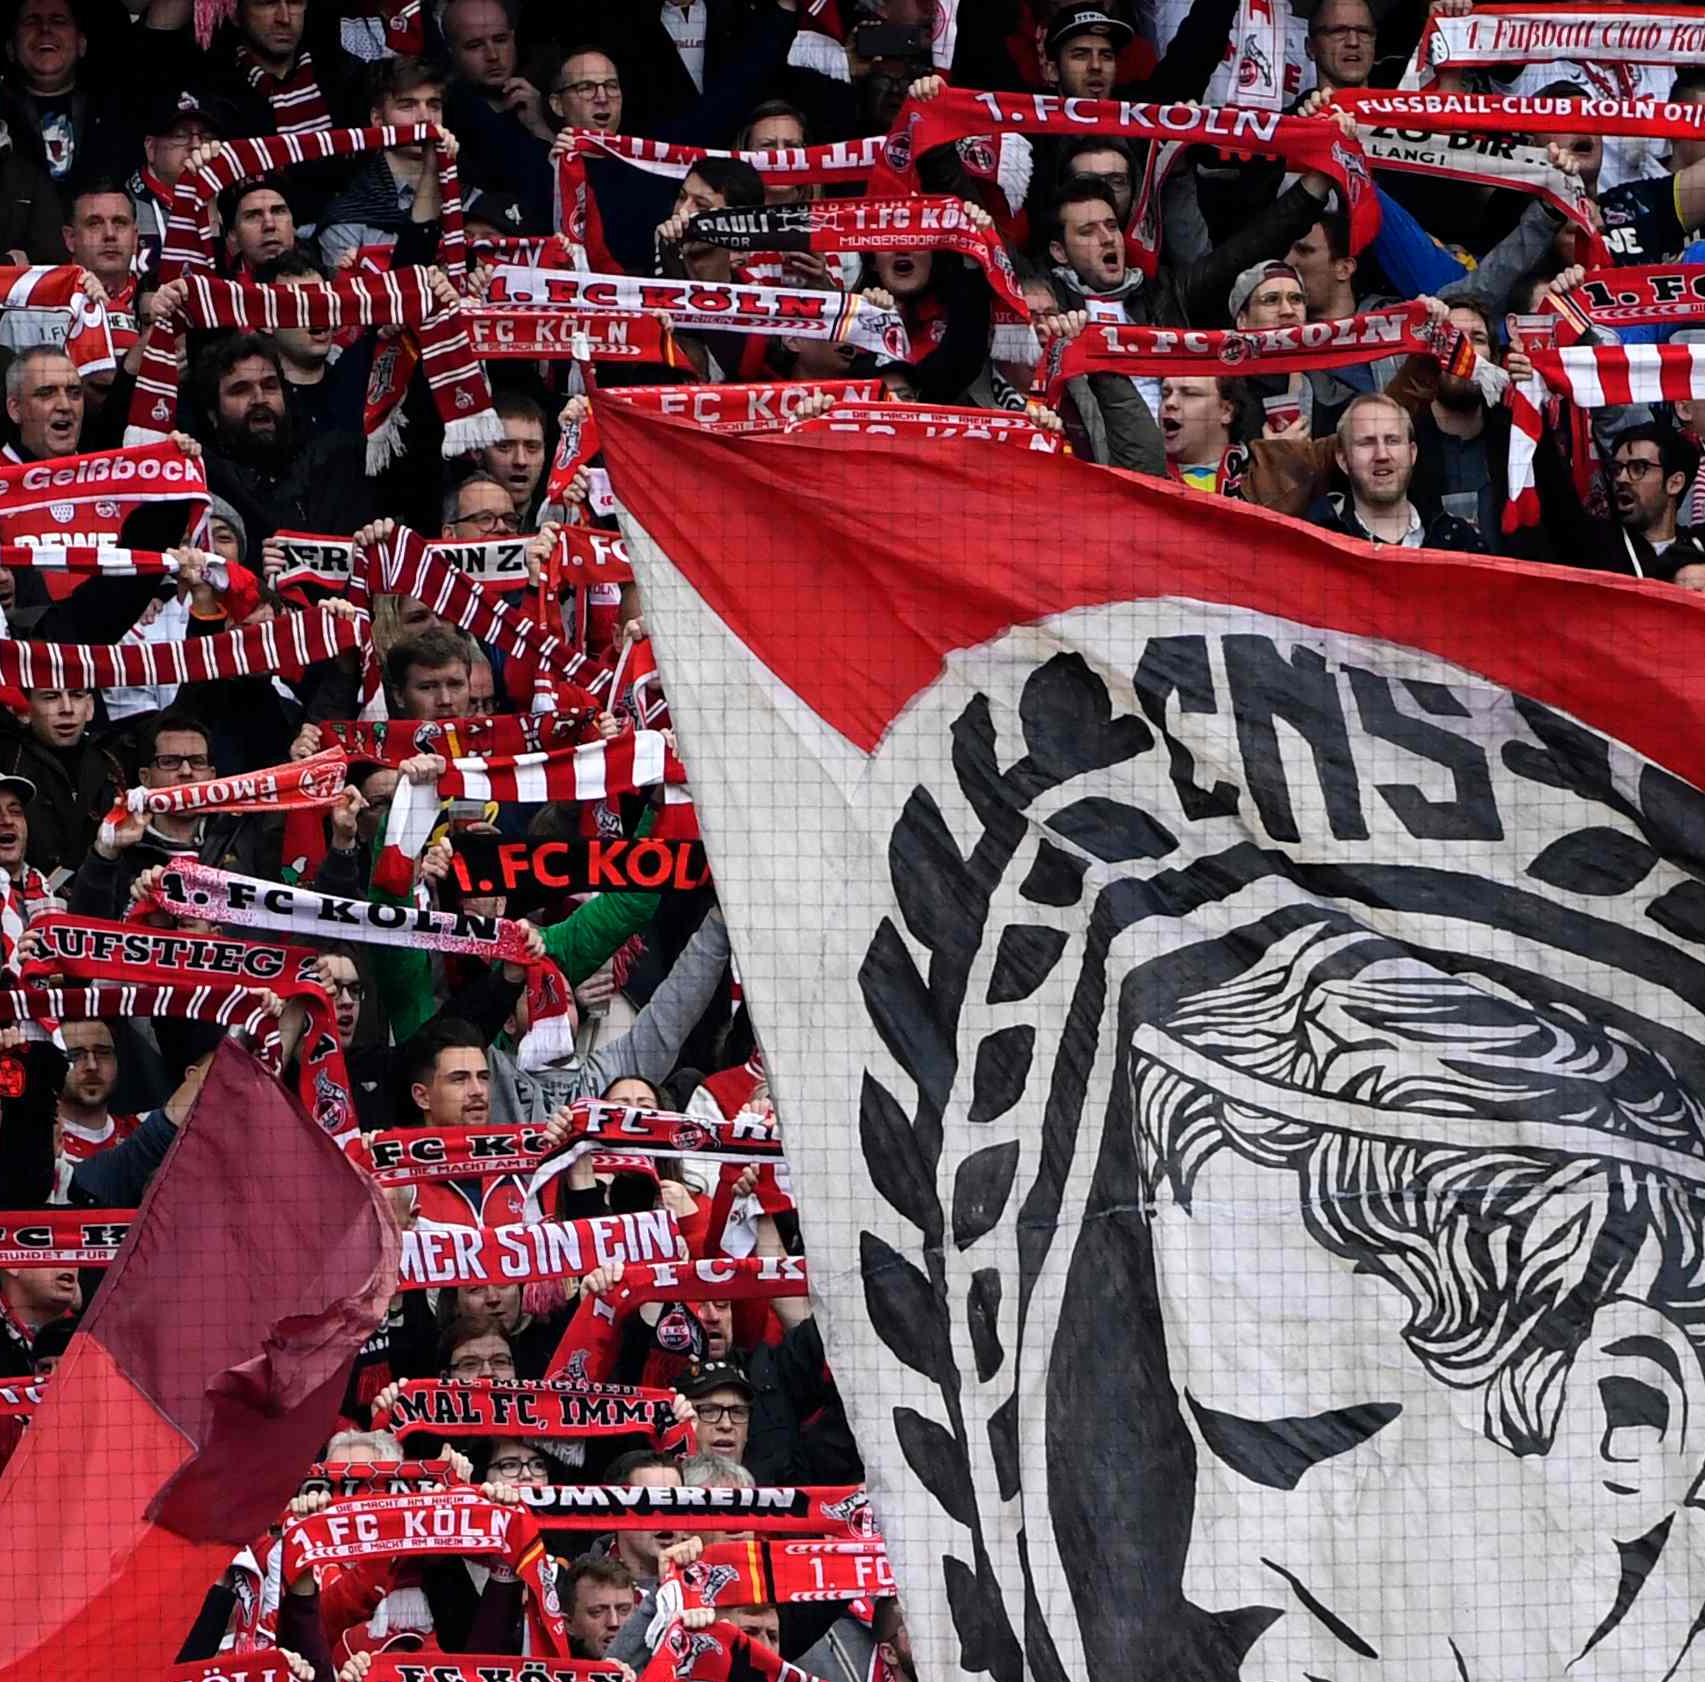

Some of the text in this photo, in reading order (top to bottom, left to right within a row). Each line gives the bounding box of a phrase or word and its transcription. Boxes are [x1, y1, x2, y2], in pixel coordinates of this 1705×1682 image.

[1492, 20, 1596, 58] Fußball
[1605, 20, 1663, 52] Club
[975, 93, 1281, 139] 1. FC KÖLN
[1358, 98, 1572, 118] FUSSBALL-CLUB
[546, 280, 825, 319] FC KÖLN
[1582, 282, 1639, 305] 1.
[535, 317, 628, 346] KÖLN
[1102, 325, 1210, 352] 1. FC
[662, 392, 722, 422] FC
[502, 841, 569, 889] FC
[161, 874, 295, 916] 1. FC
[371, 1137, 444, 1169] FC
[328, 1509, 510, 1546] FC KÖLN
